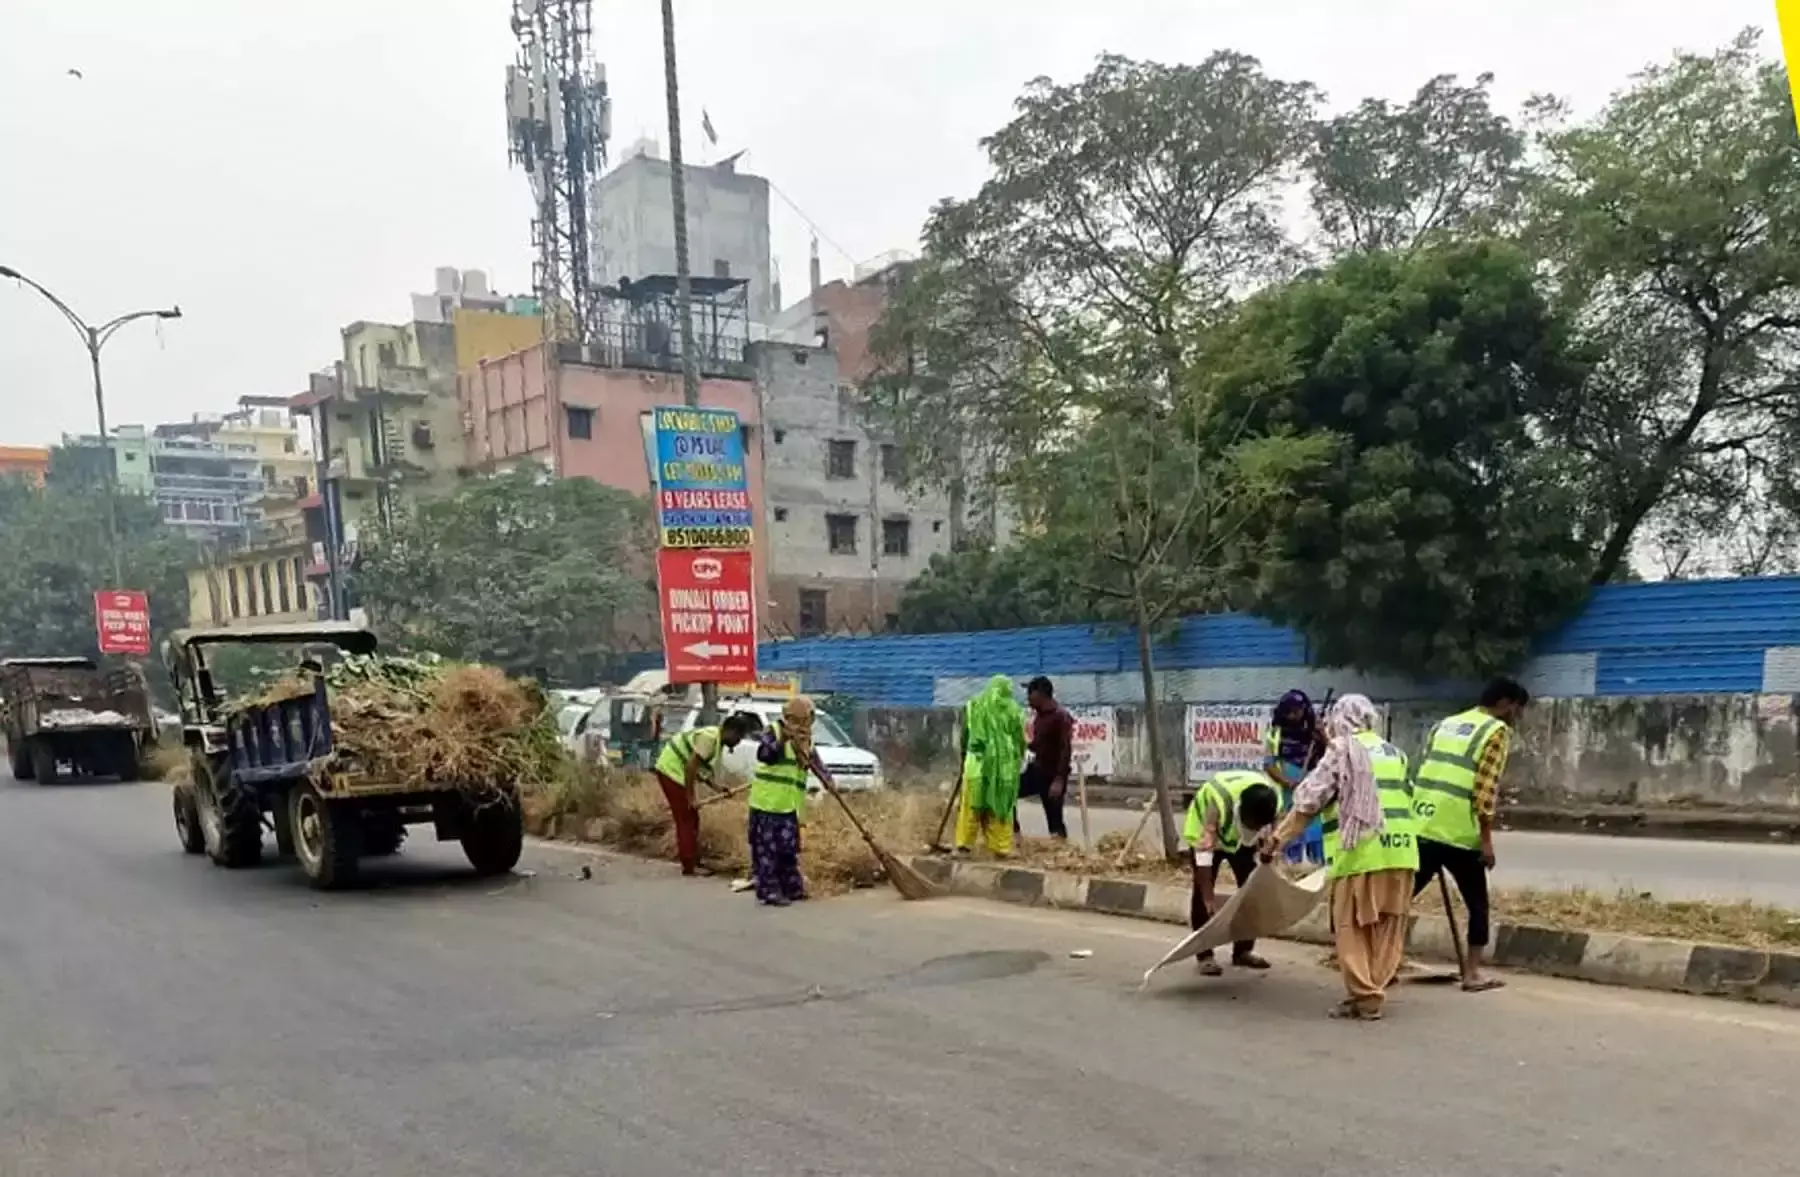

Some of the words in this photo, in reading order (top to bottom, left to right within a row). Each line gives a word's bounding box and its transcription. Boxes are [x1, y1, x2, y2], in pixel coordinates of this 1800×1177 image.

[665, 491, 672, 509] 9
[674, 491, 712, 510] YEARS
[713, 492, 747, 510] LEASE
[671, 612, 713, 634] PICKUP
[717, 613, 749, 634] POINT
[1380, 833, 1411, 849] MCG
